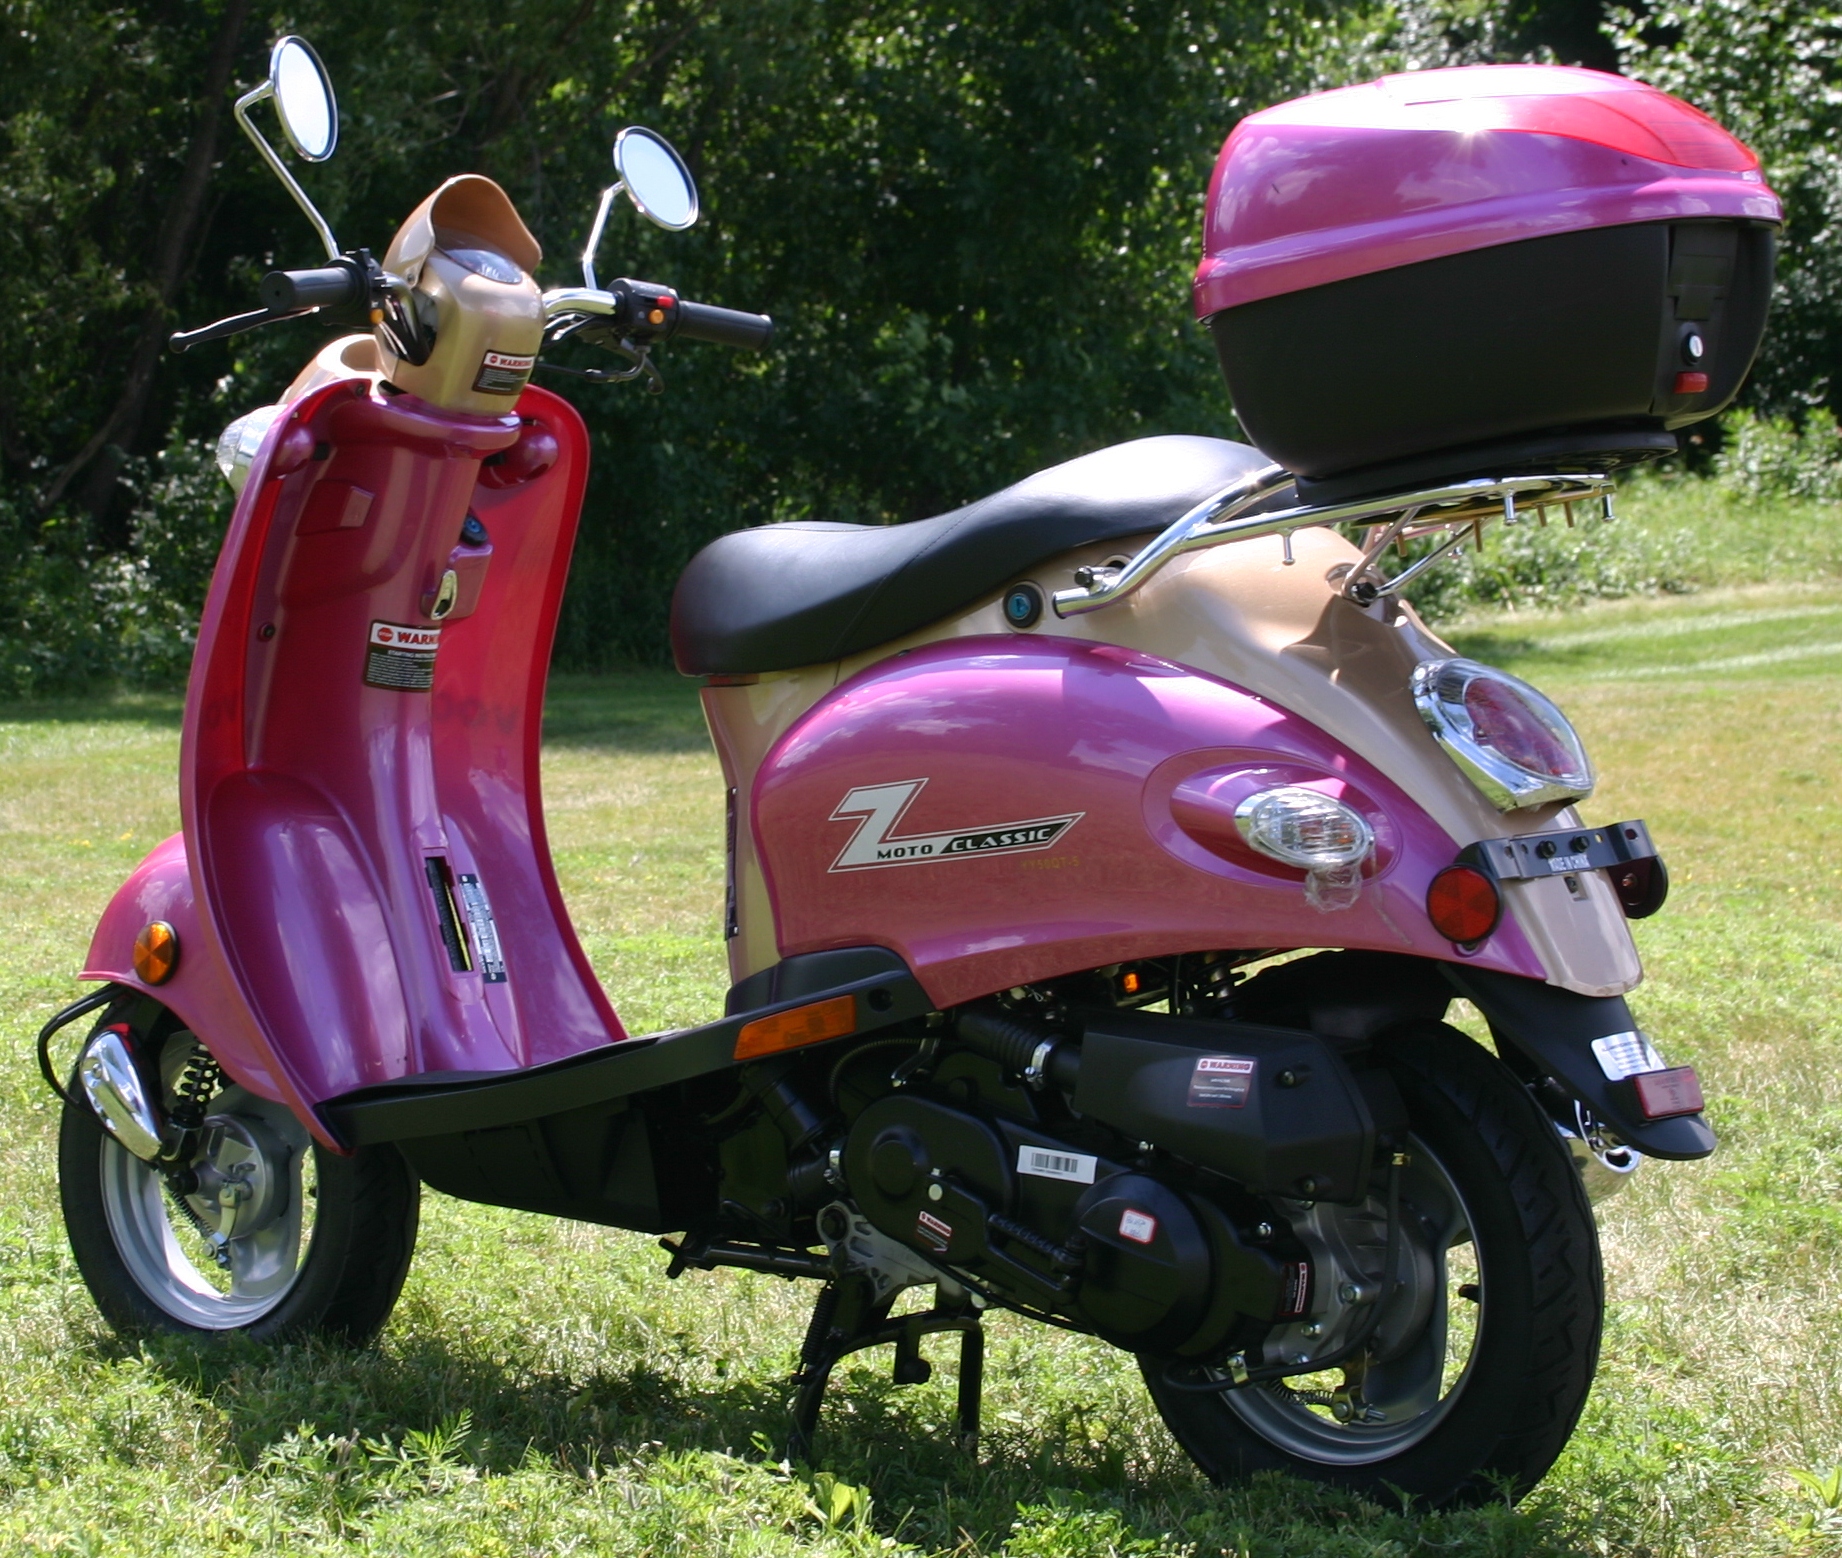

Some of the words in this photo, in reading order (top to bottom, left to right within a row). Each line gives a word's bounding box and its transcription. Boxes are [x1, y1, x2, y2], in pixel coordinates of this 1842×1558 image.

[877, 844, 933, 860] MOTO
[950, 828, 1051, 851] CLASSIC
[1548, 857, 1567, 871] MADE
[1209, 1060, 1251, 1071] WARNING
